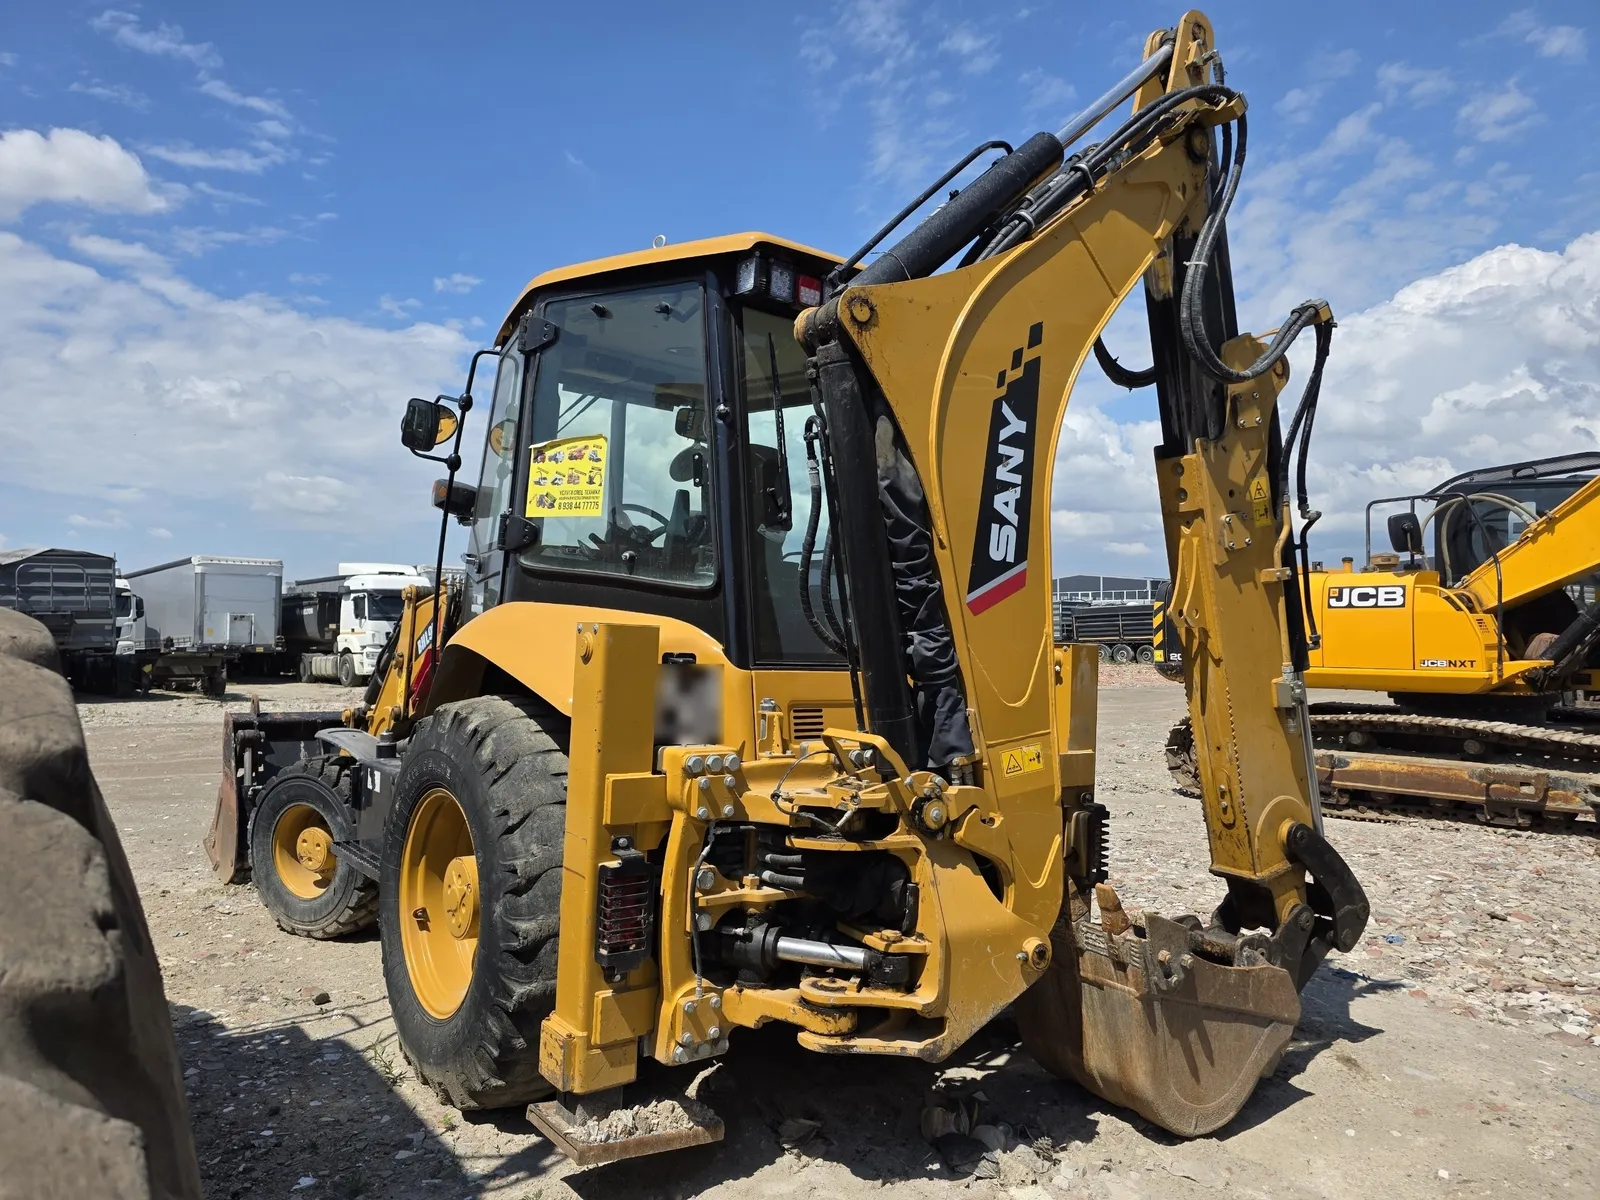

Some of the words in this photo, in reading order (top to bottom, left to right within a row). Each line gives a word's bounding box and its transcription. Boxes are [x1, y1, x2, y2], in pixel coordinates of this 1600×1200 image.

[989, 400, 1027, 563] SANY
[574, 501, 581, 509] 44
[582, 501, 599, 510] 77775
[1329, 587, 1405, 607] JCB
